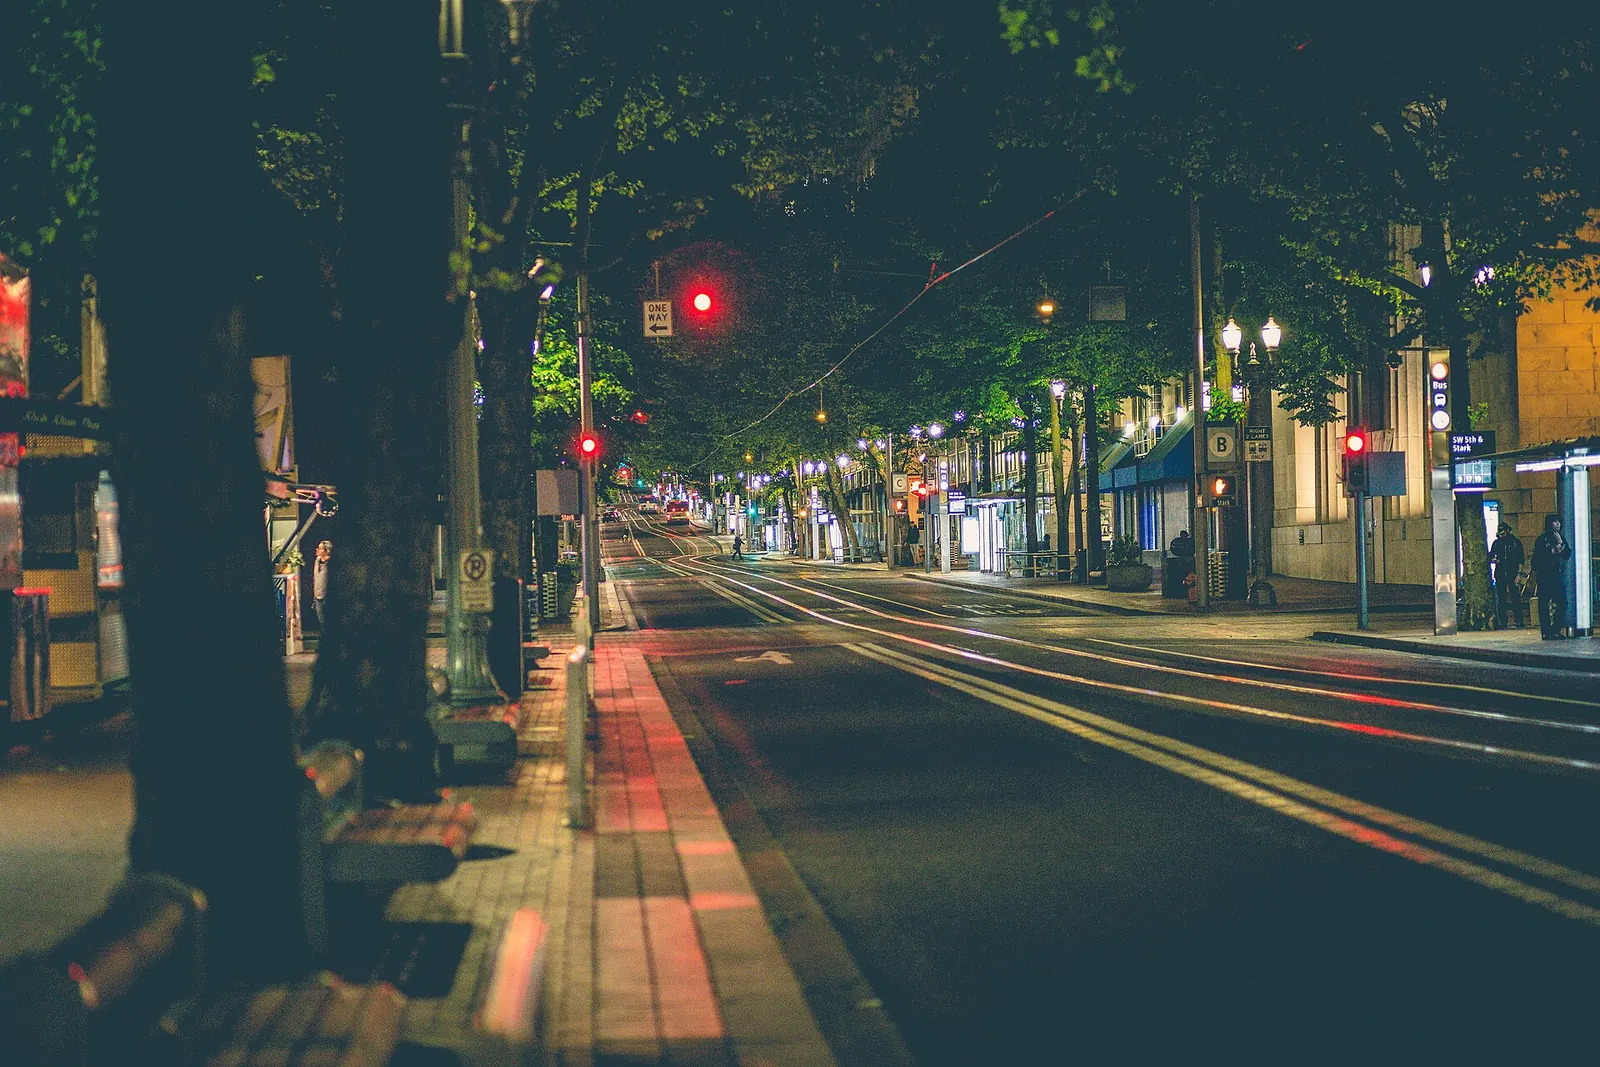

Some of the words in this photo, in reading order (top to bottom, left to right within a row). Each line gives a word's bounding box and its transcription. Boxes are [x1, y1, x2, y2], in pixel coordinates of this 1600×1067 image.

[648, 304, 667, 312] ONE
[648, 313, 668, 321] WAY
[1432, 381, 1448, 389] Bus
[1452, 435, 1464, 443] SW
[1464, 435, 1477, 443] 5th
[1478, 435, 1484, 443] &
[1217, 437, 1227, 452] B
[1452, 444, 1472, 452] Stark
[897, 479, 903, 487] C
